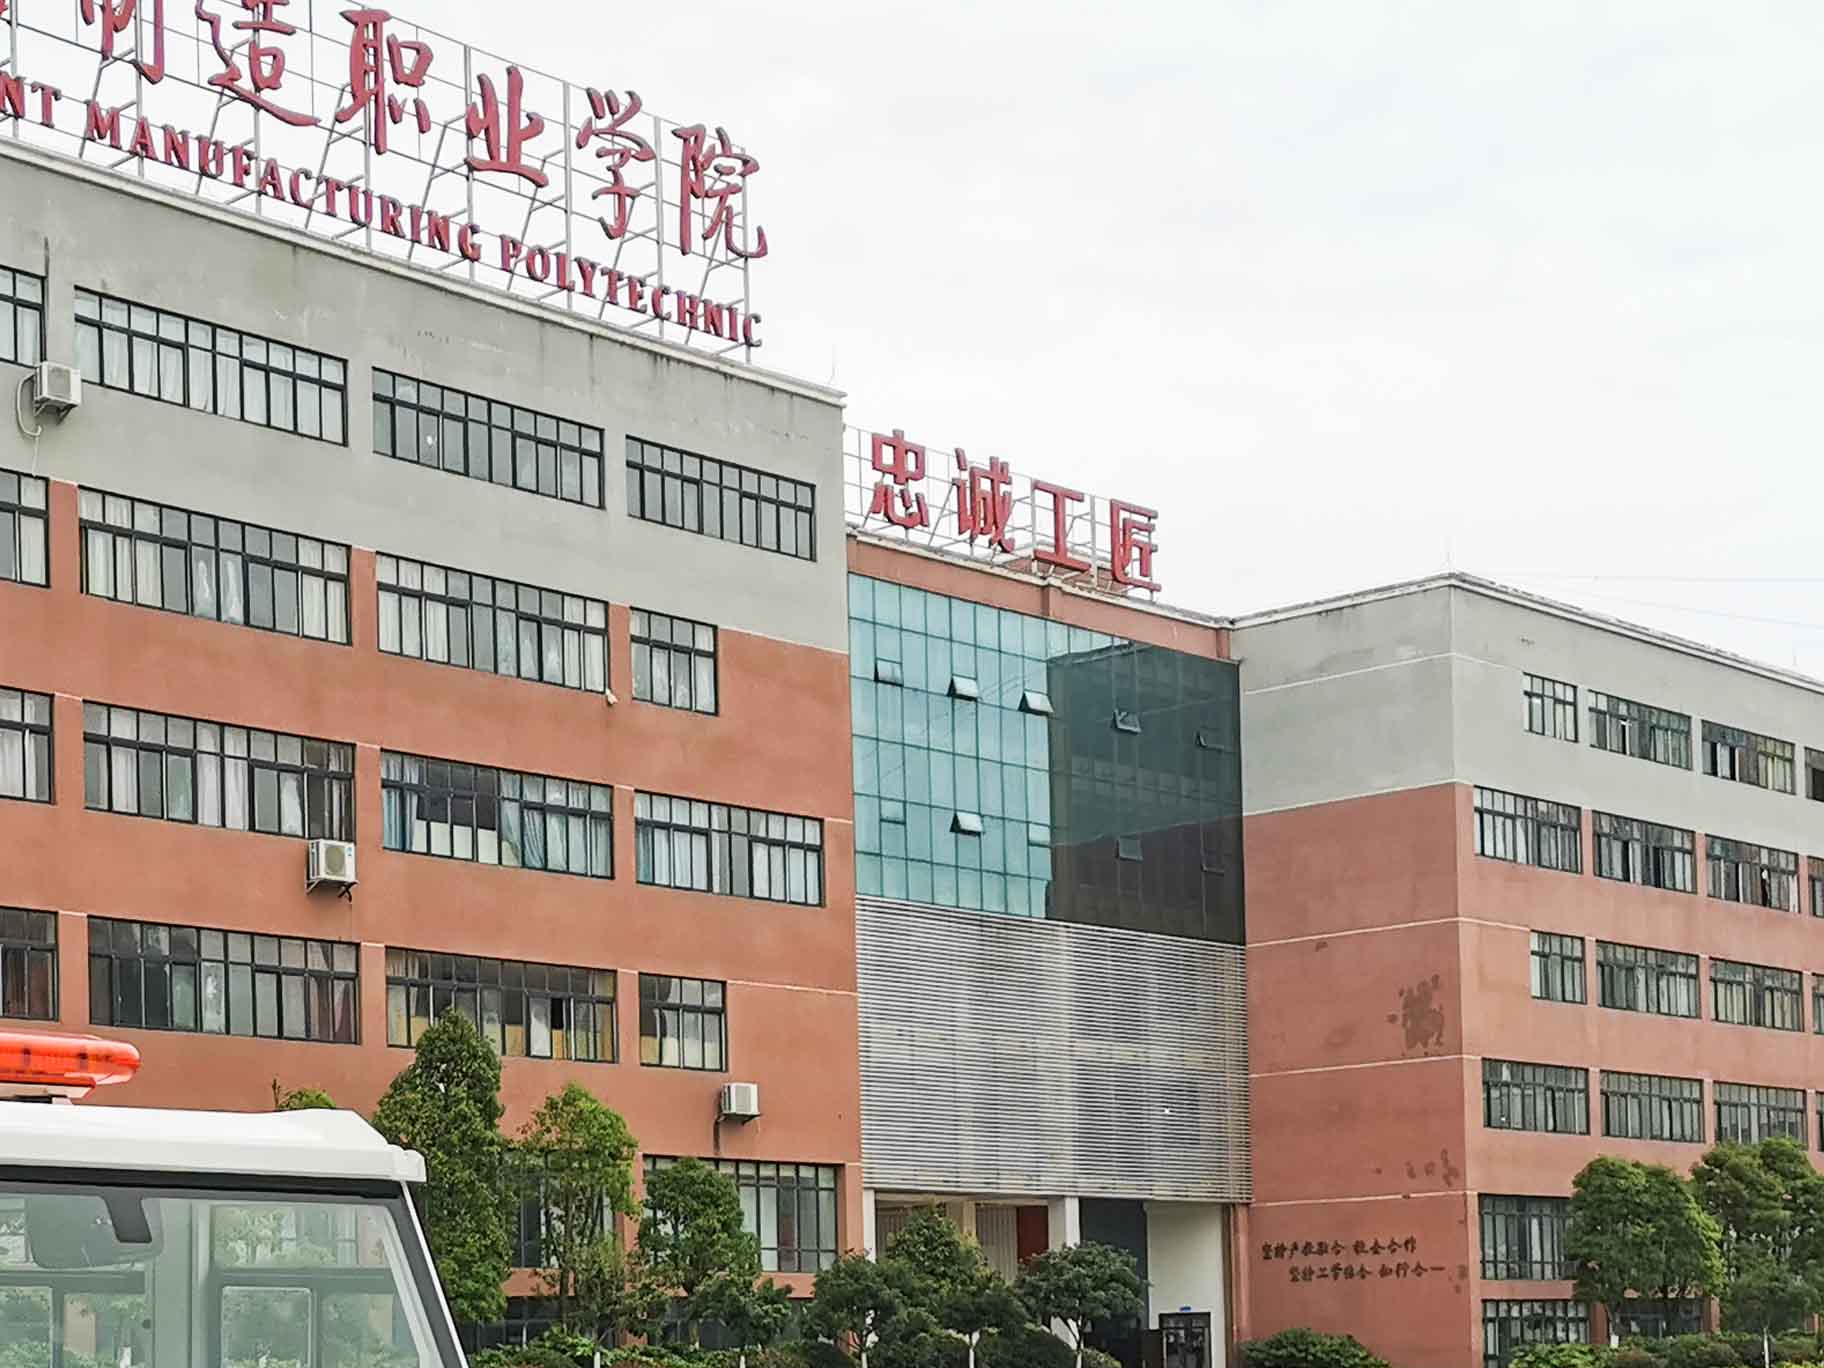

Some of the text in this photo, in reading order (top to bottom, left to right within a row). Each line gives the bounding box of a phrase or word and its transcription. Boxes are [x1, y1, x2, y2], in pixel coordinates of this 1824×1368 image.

[85, 99, 482, 262] MANUFACTURING
[499, 233, 763, 347] POLYTECHNIC
[871, 428, 1162, 593] 忠诚工匠
